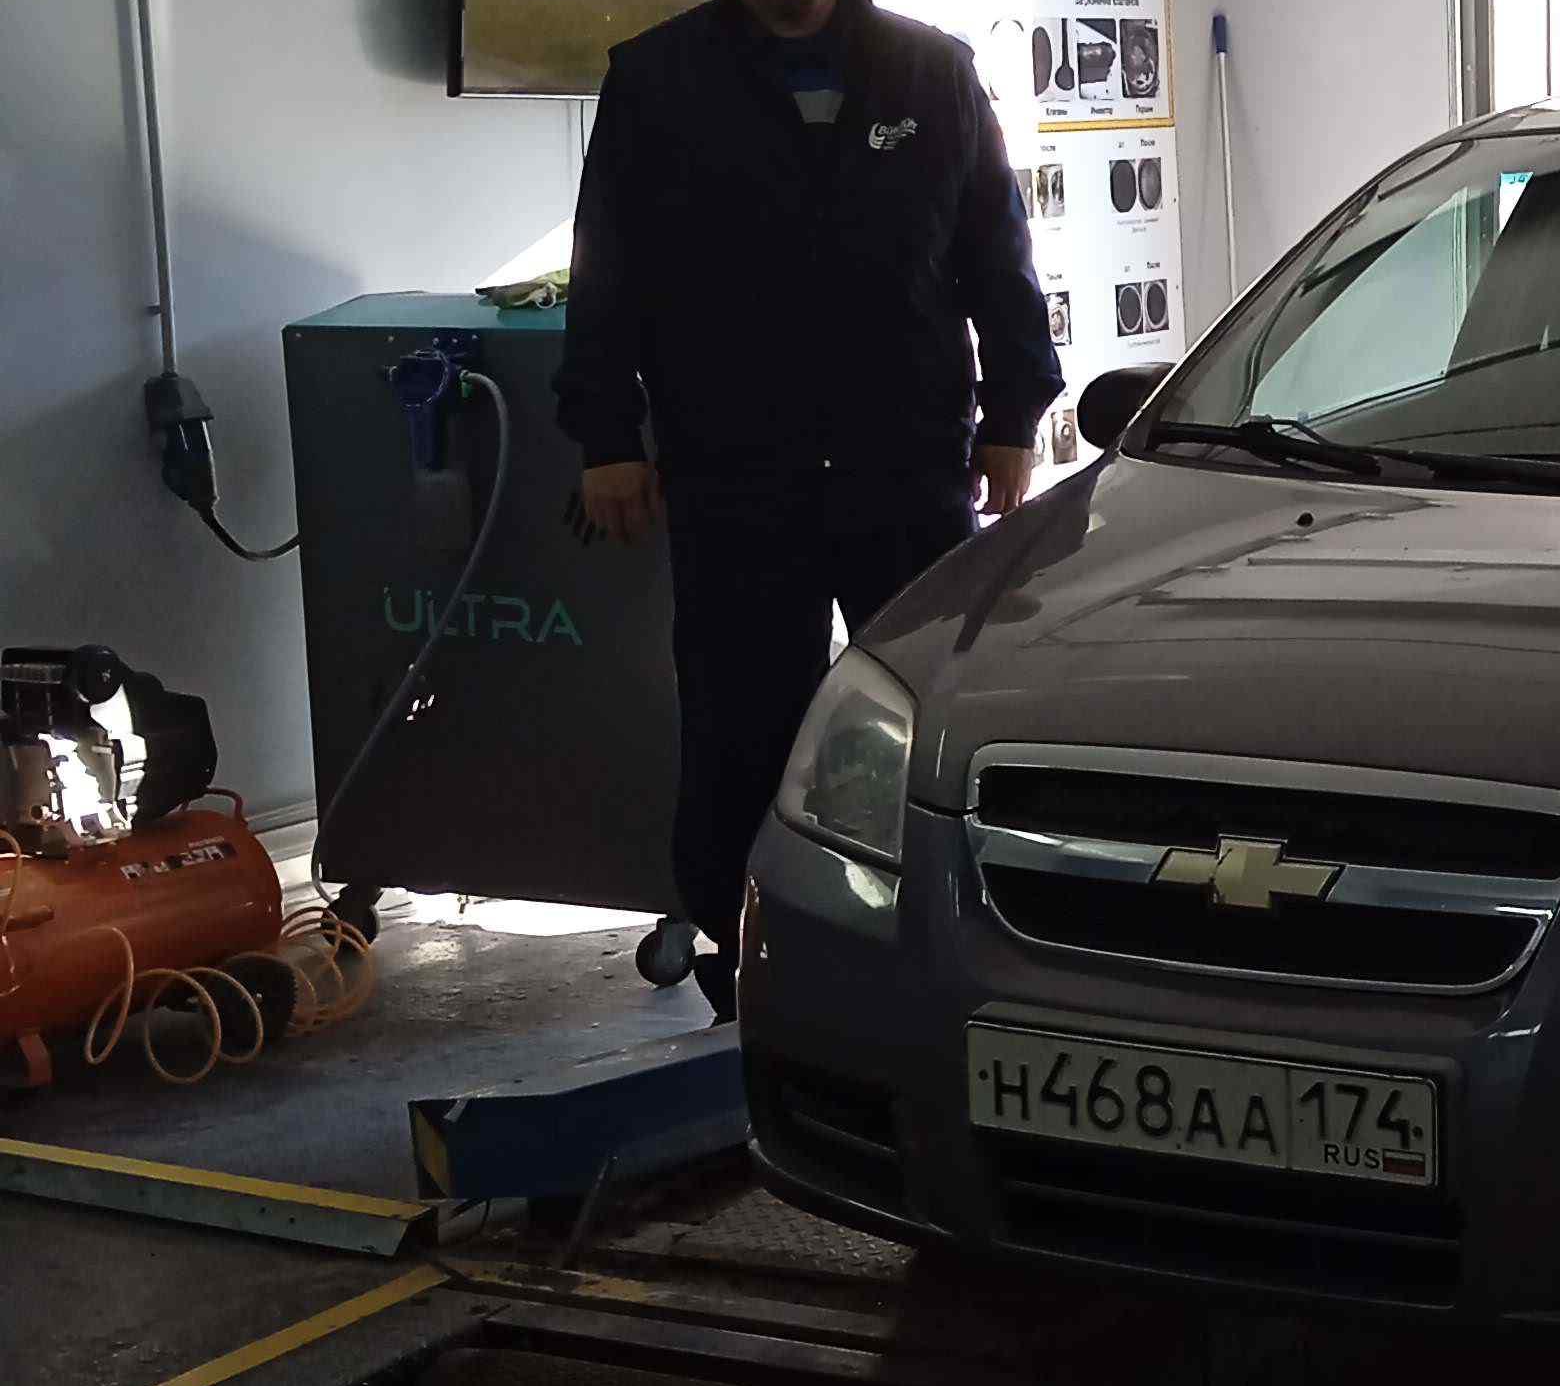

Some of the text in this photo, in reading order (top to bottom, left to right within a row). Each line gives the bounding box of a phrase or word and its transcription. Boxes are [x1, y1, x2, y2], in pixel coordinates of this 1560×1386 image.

[383, 587, 585, 647] ULTRA
[991, 1051, 1413, 1156] Н468АА 174
[1323, 1144, 1381, 1170] RUS
